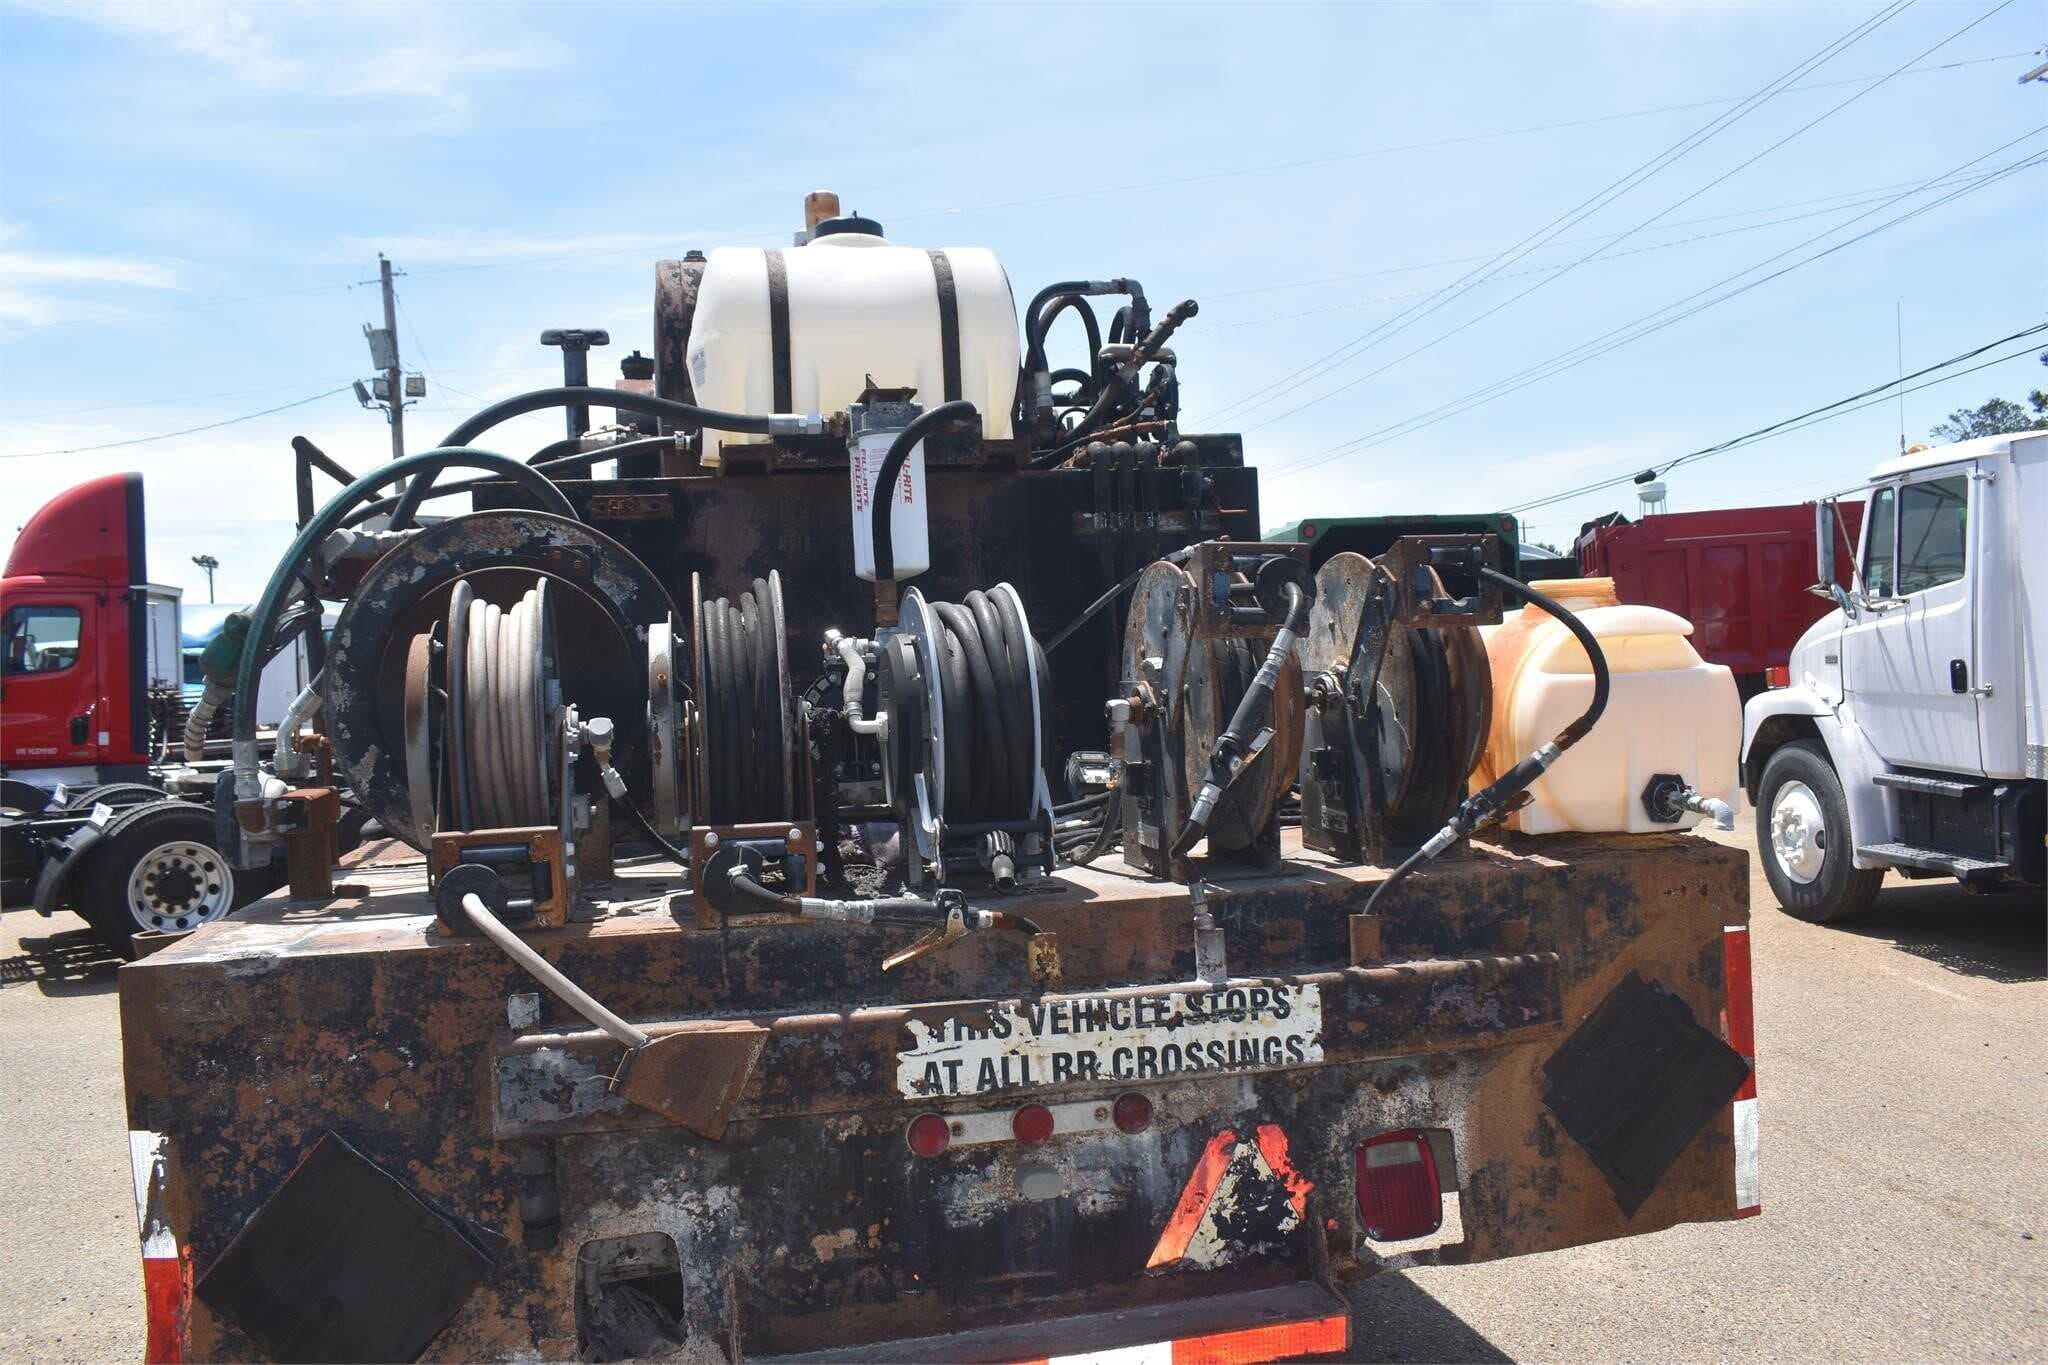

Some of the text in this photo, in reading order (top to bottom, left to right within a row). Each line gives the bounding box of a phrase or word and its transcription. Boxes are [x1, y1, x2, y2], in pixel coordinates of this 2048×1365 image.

[855, 456, 863, 512] FILL-RITE
[1185, 986, 1291, 1025] STOPS
[923, 1034, 1306, 1096] AT ALL RR CROSSINGS
